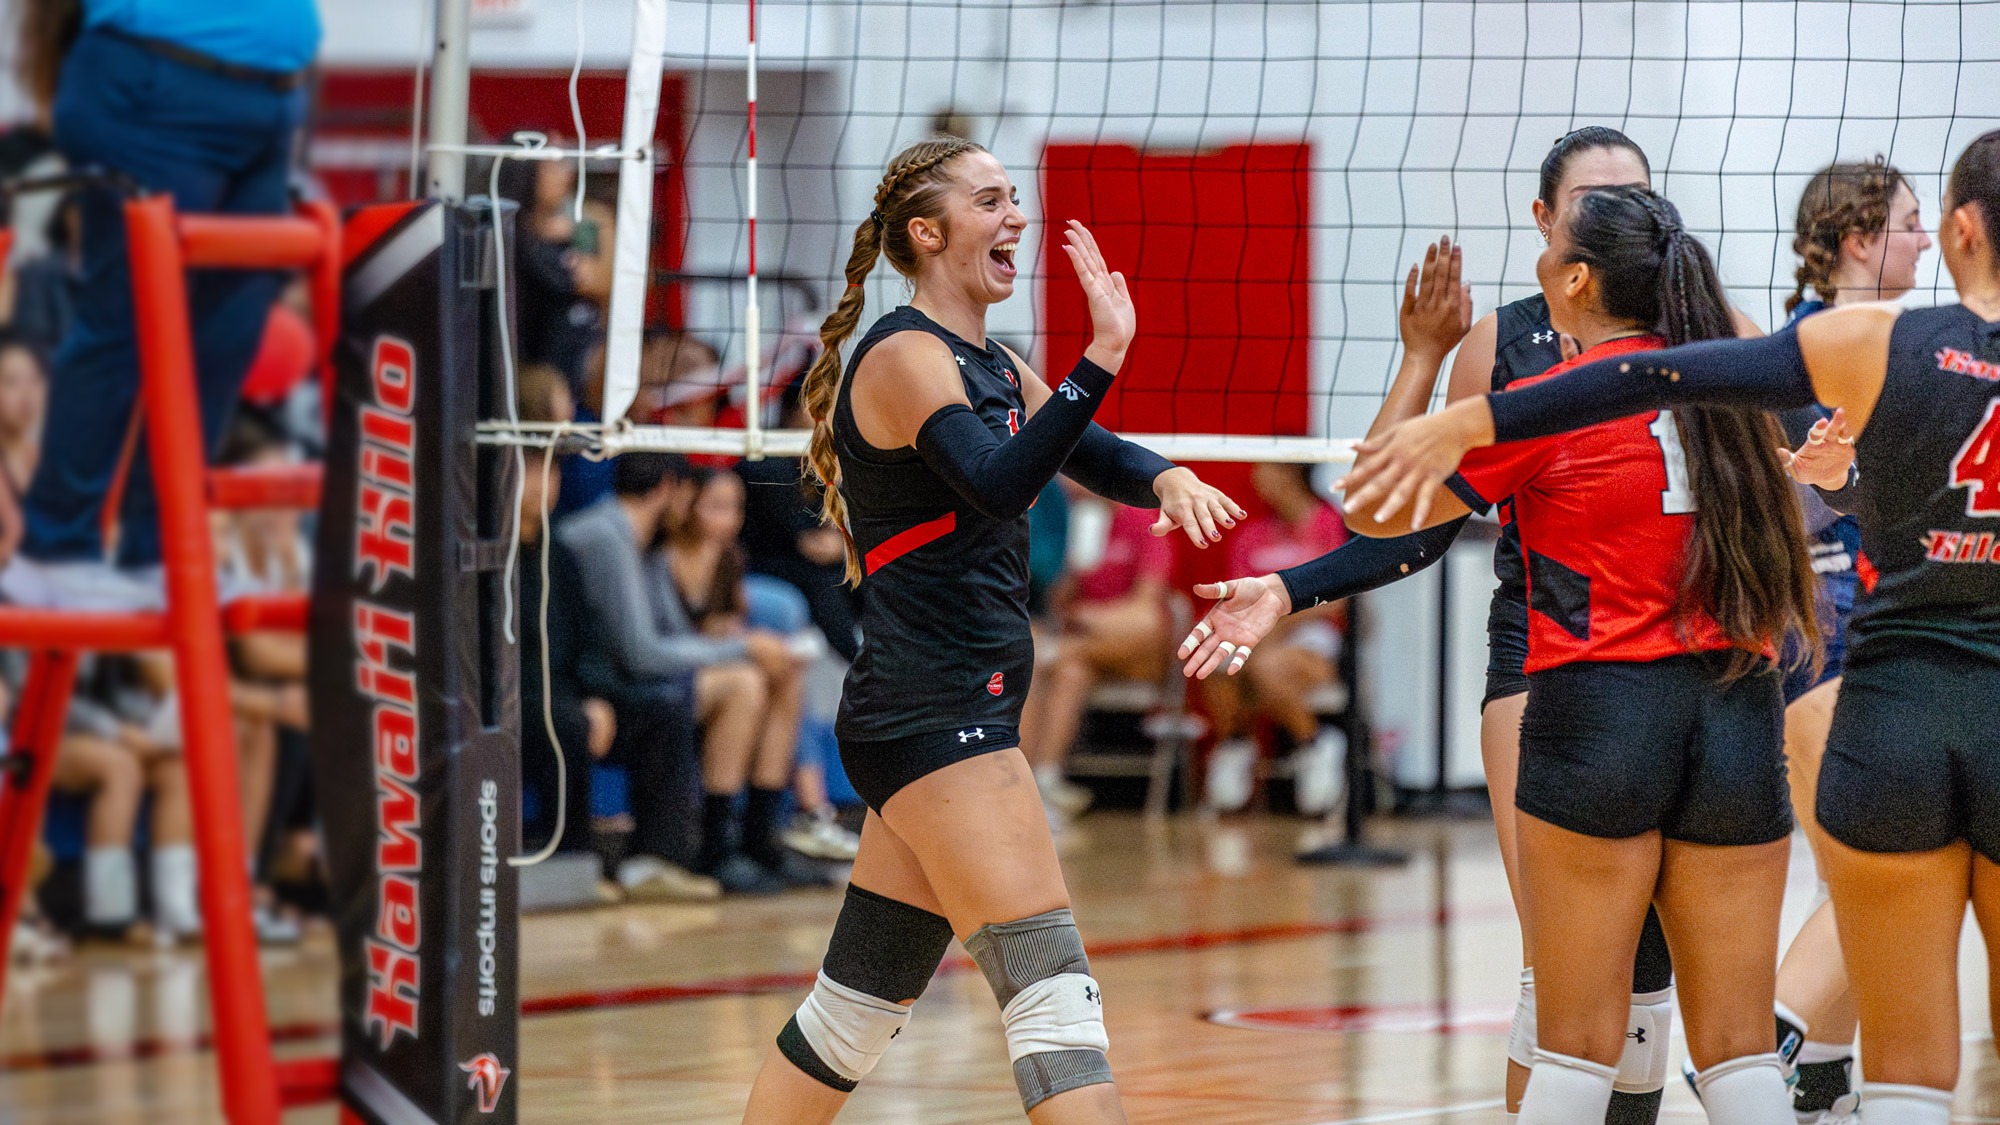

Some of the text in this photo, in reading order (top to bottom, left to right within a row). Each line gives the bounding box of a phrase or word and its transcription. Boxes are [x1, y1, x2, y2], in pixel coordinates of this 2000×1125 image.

[355, 334, 416, 593] Hilo
[1648, 408, 1699, 515] 1
[1949, 396, 2000, 517] 4
[475, 779, 500, 1017] sports imports
